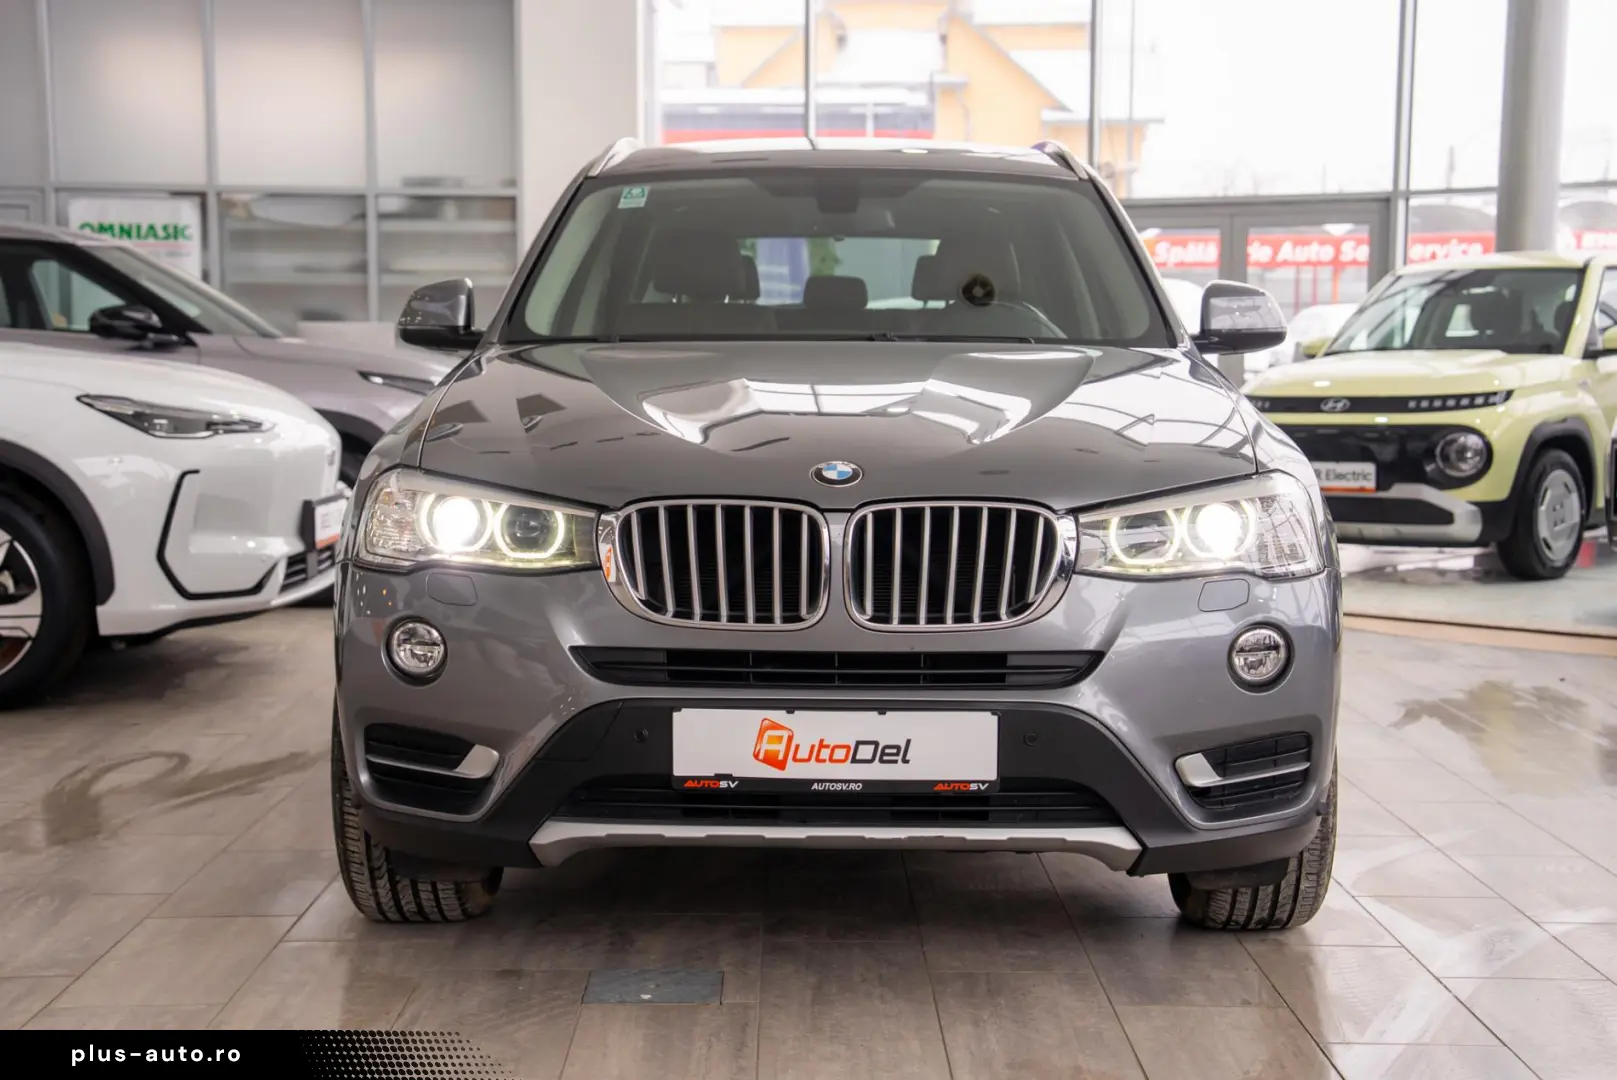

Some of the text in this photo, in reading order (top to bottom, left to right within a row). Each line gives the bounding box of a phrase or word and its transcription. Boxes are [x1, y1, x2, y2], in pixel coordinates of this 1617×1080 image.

[1276, 239, 1334, 263] Auto
[1408, 238, 1484, 260] ervice
[1326, 469, 1372, 481] Electric
[756, 722, 911, 769] AutoDel
[684, 780, 739, 789] AUTOSV
[811, 783, 862, 792] AUTOSV.RO
[933, 783, 989, 792] AUTOSV
